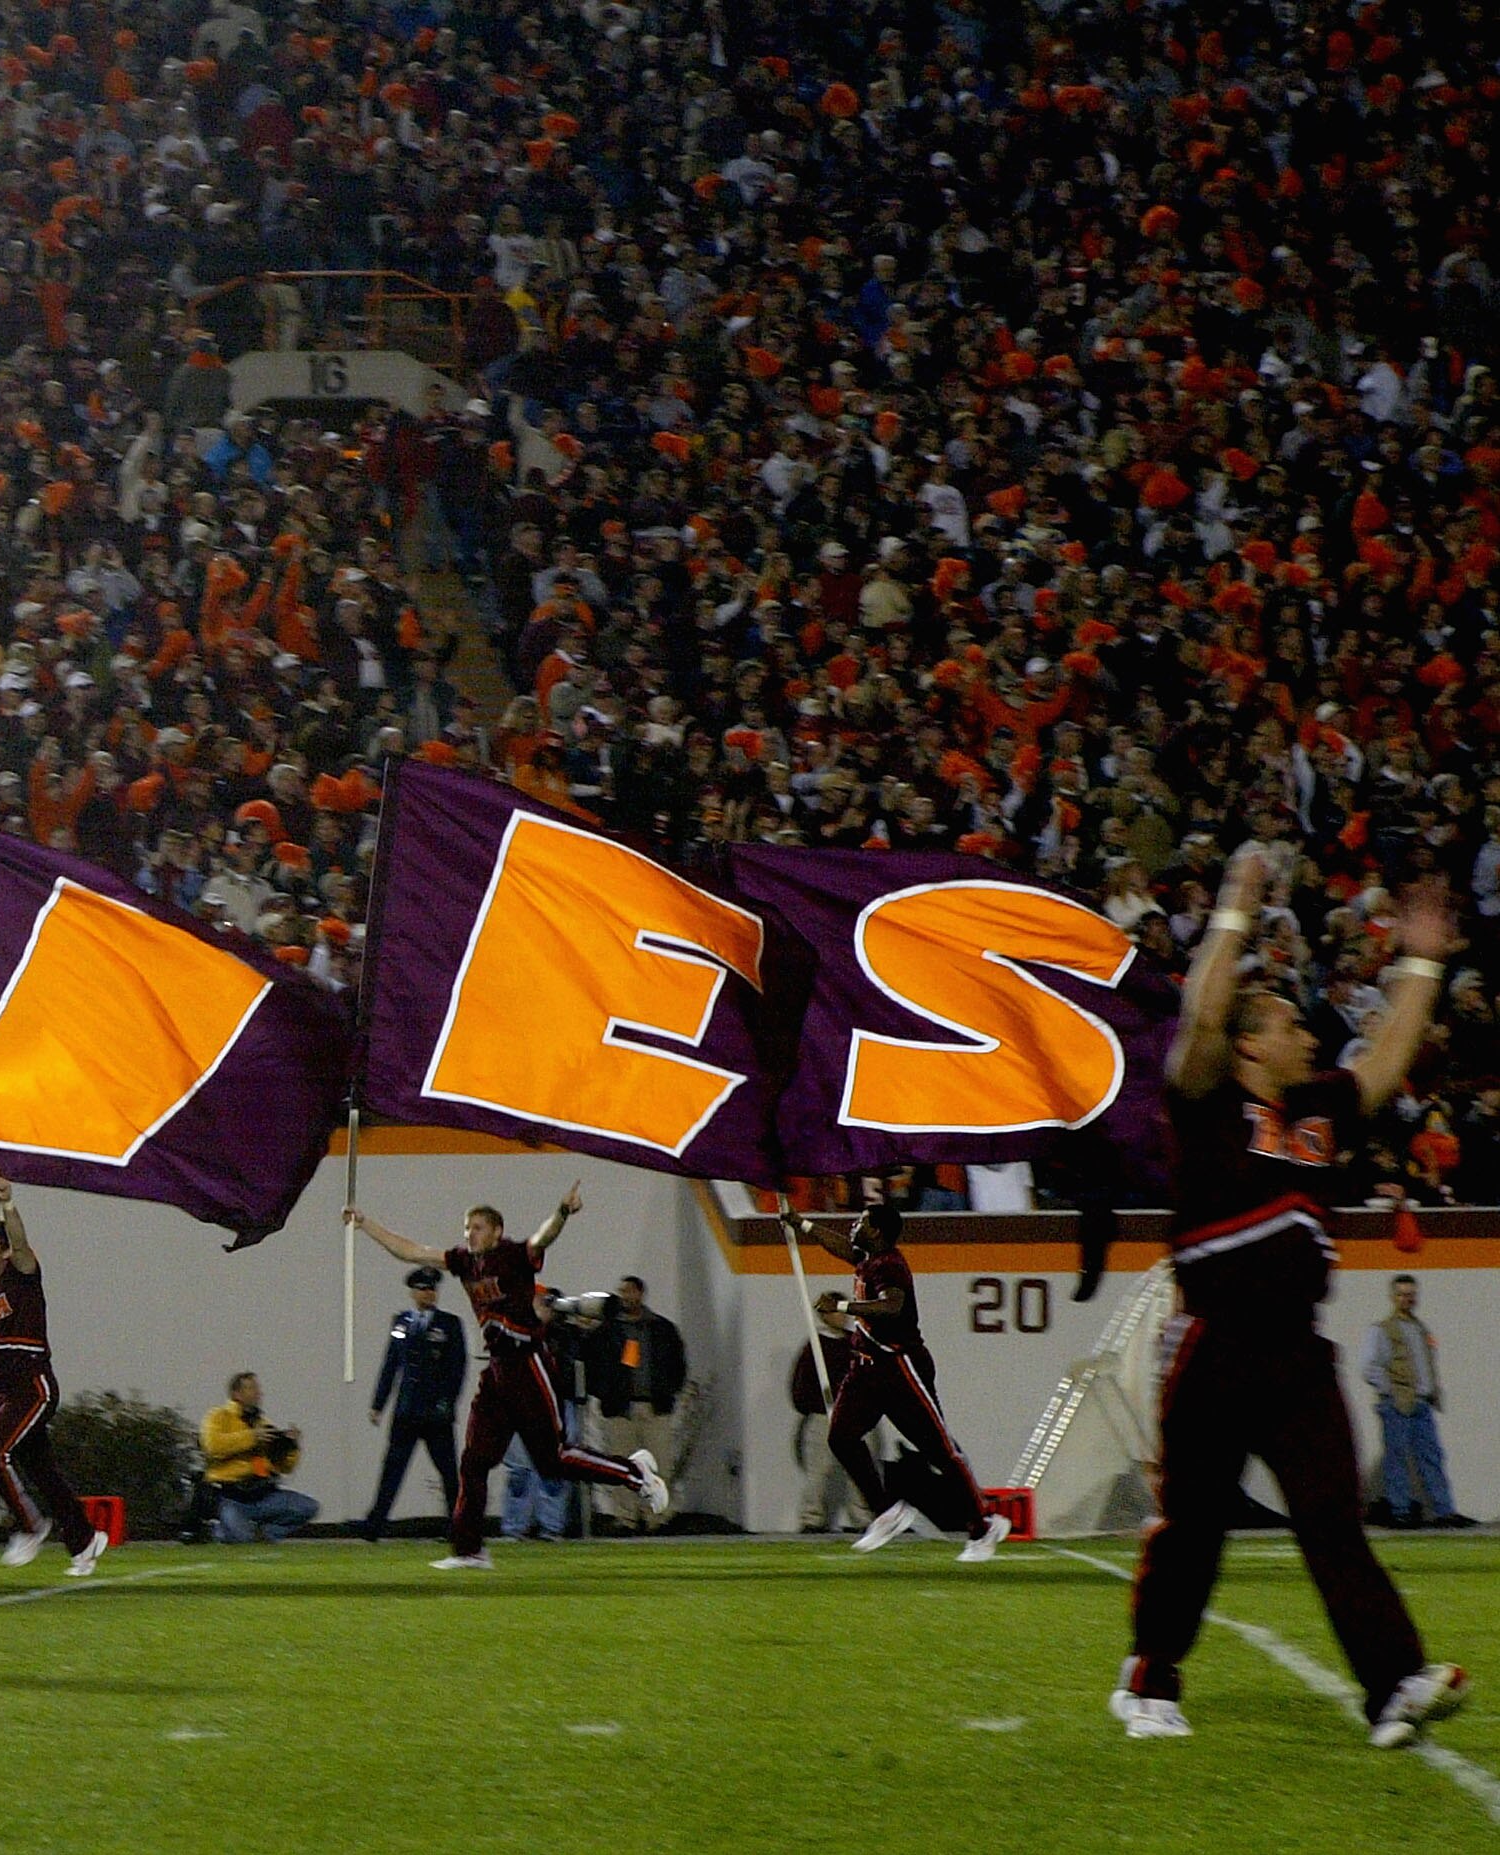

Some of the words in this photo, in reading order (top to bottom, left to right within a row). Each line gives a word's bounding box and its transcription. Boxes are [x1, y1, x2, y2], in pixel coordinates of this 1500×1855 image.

[421, 808, 765, 1158] E
[837, 879, 1139, 1133] S
[972, 1277, 1050, 1333] 20
